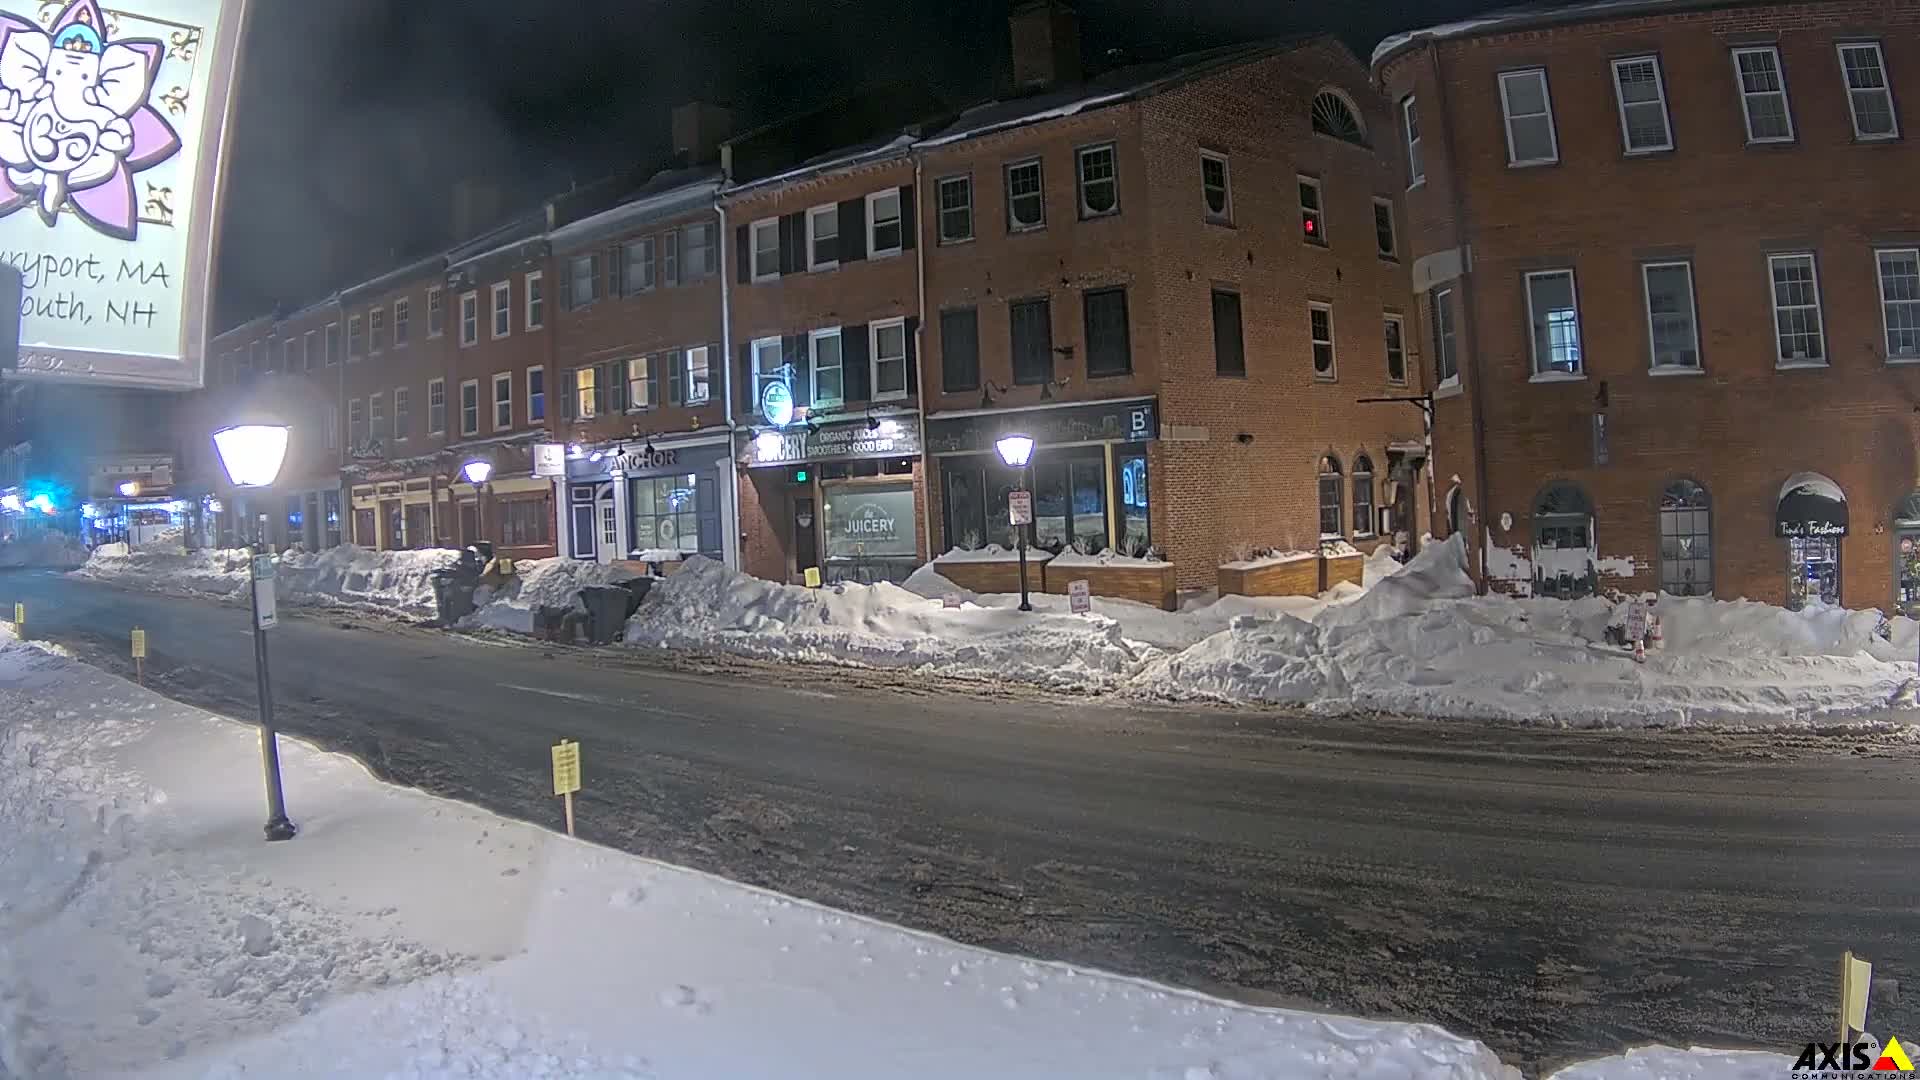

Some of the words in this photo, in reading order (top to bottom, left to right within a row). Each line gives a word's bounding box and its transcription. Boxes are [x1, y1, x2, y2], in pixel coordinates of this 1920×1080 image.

[0, 250, 105, 289] ryport,
[116, 258, 170, 288] MA
[20, 291, 92, 325] outh,
[106, 299, 158, 328] NH
[819, 430, 851, 443] ORGANIC
[757, 430, 807, 462] CERY
[807, 443, 847, 457] SMOOTHIES
[853, 440, 875, 453] GOOD
[610, 450, 677, 470] ANCHOR
[844, 517, 895, 533] JUICERY
[1781, 521, 1804, 535] Tina's
